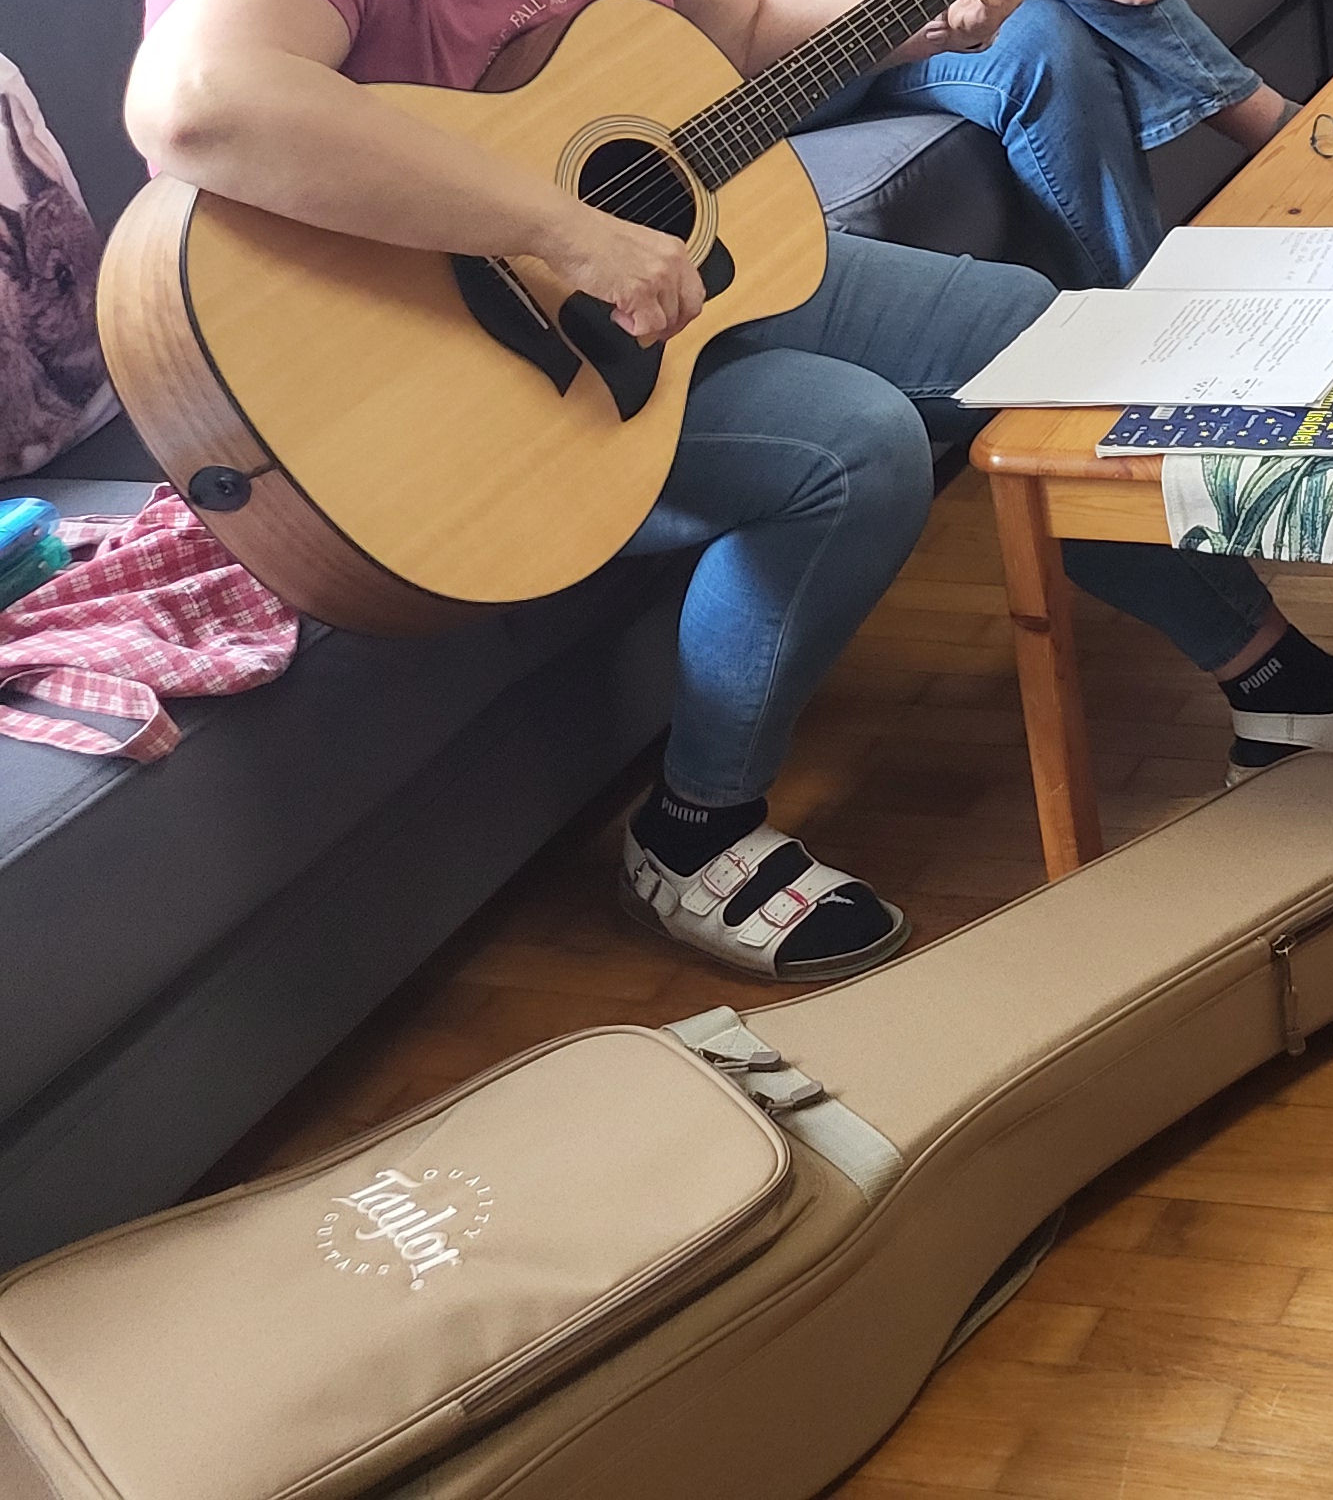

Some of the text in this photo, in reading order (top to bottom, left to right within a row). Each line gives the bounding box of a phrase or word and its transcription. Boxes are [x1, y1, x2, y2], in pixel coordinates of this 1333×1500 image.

[1239, 657, 1283, 694] PUMA
[661, 796, 709, 823] PUMA
[331, 1169, 464, 1274] Taylor
